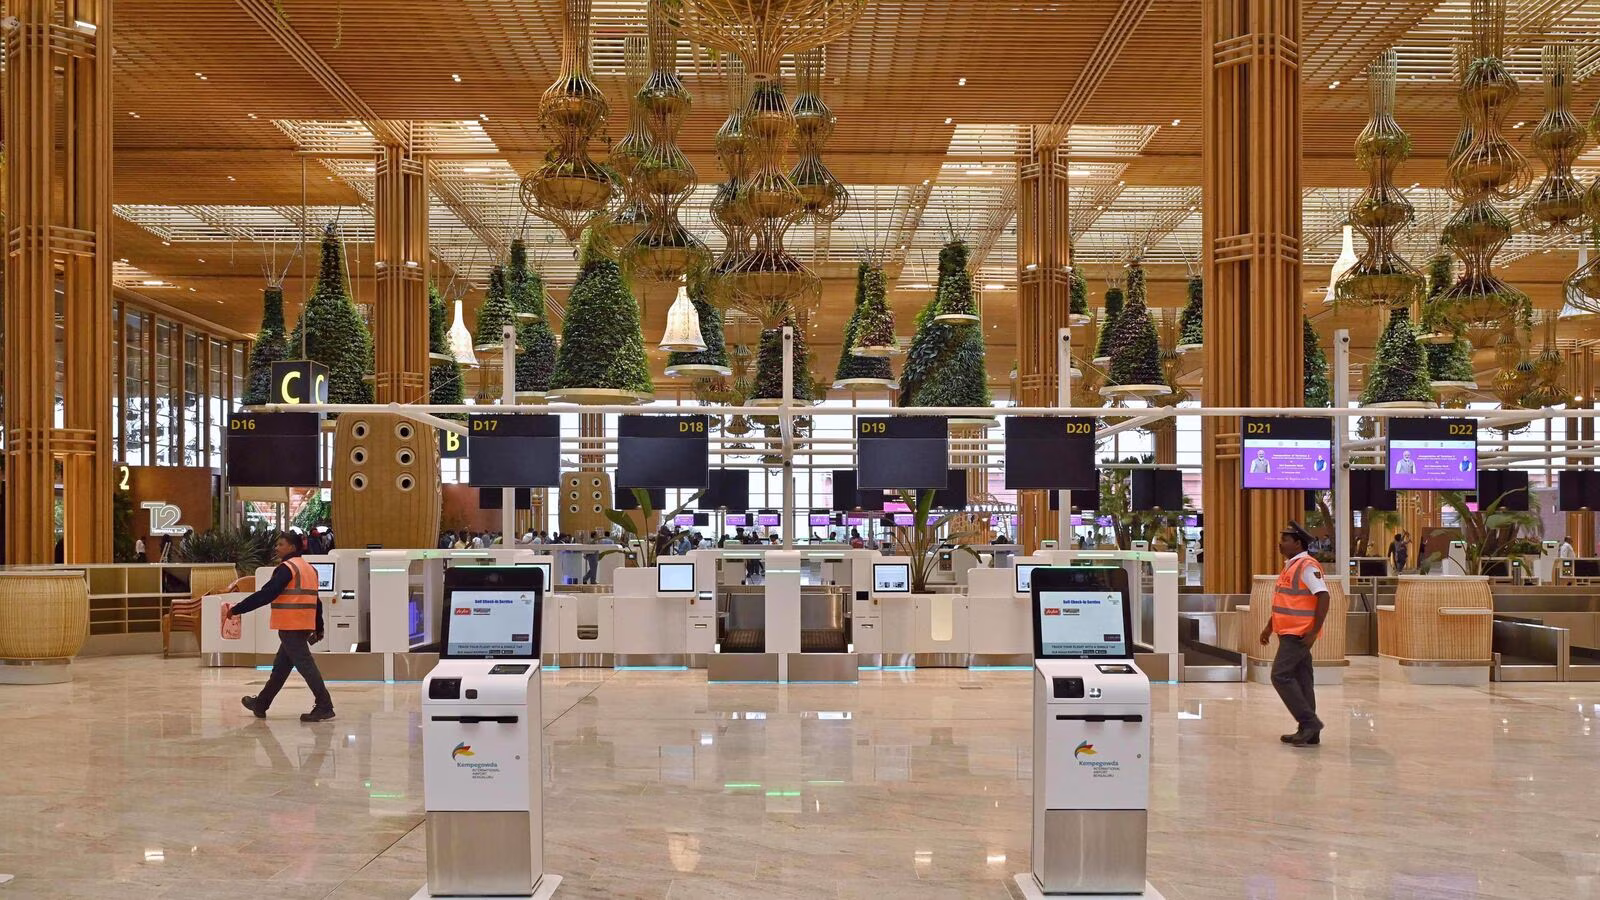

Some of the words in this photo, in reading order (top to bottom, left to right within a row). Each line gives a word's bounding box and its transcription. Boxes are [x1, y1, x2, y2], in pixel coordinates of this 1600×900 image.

[281, 370, 301, 404] C
[315, 374, 324, 404] C
[231, 419, 256, 430] D16
[473, 420, 497, 431] D17
[679, 421, 704, 433] D18
[861, 423, 886, 433] D19
[1066, 423, 1091, 433] D20
[1247, 423, 1271, 434] D21
[1449, 424, 1473, 435] D22
[446, 429, 460, 452] B
[119, 465, 130, 490] 2
[141, 501, 191, 534] T2
